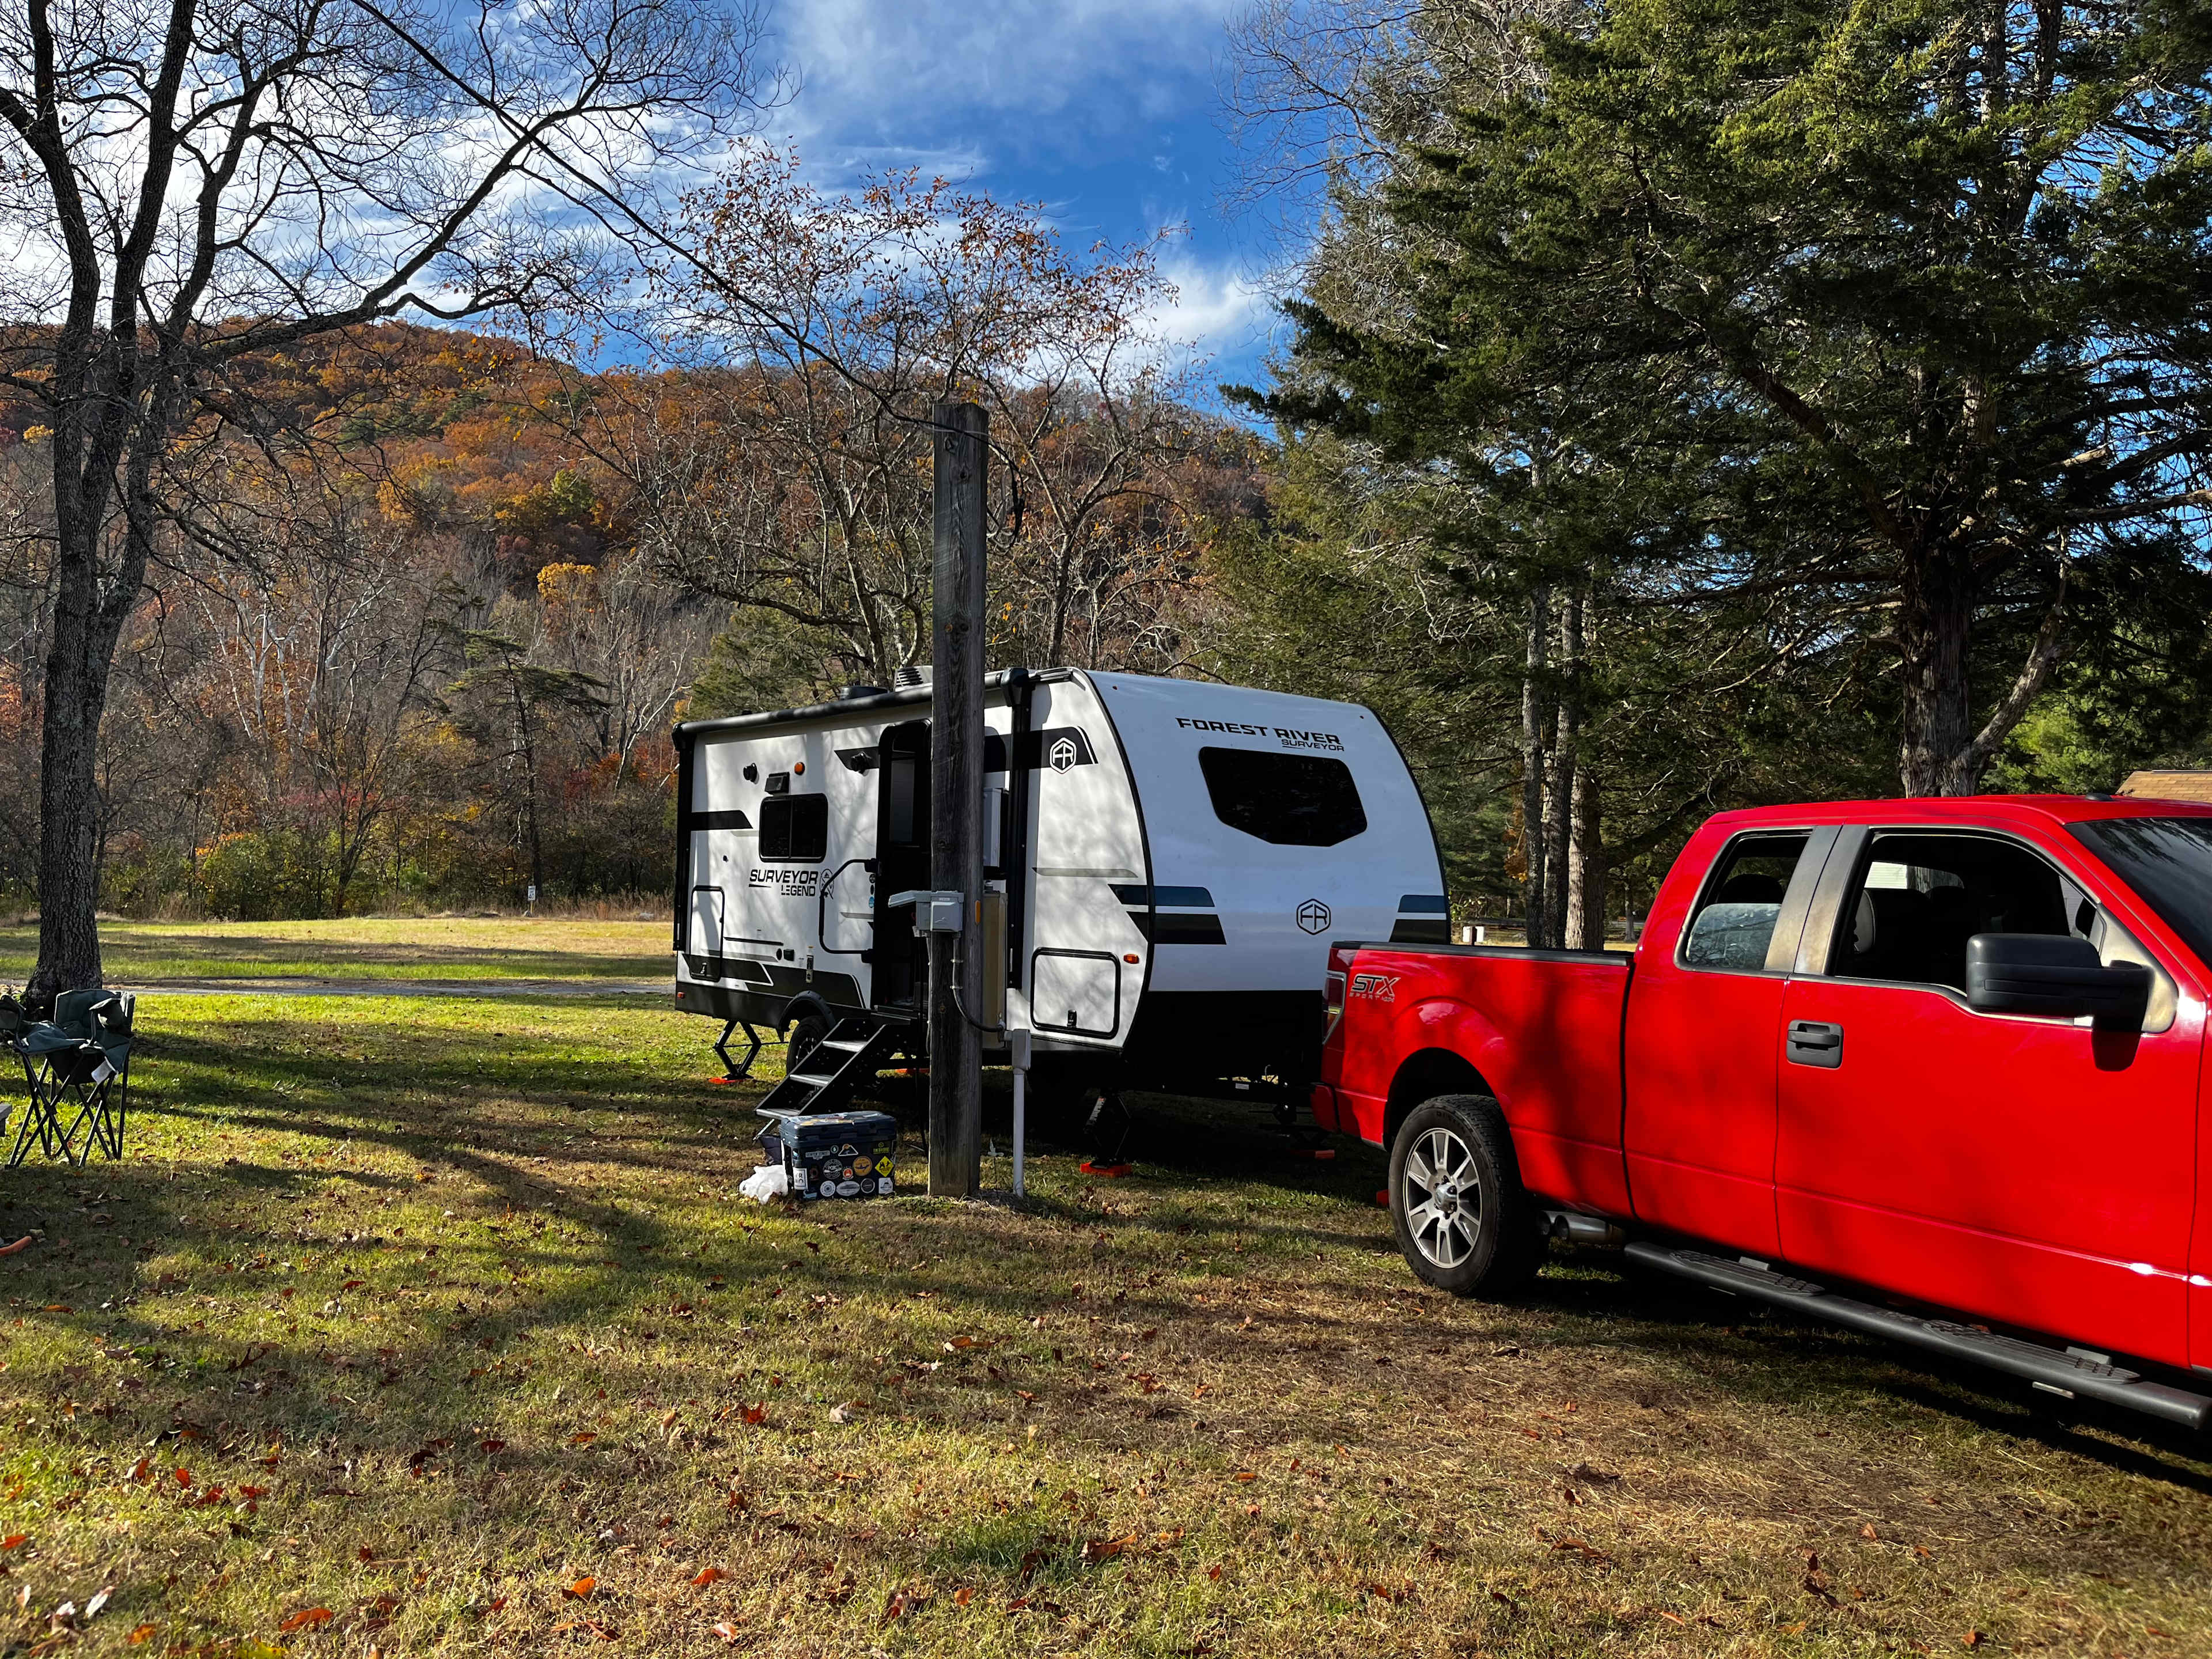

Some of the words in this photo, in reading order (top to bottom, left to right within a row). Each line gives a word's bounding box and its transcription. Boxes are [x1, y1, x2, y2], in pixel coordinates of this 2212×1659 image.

[1175, 717, 1268, 737] FOREST
[1272, 728, 1342, 745] RIVER
[1281, 739, 1345, 752] SURVEYOR
[749, 869, 819, 884] SURVEYOR
[781, 884, 816, 897] LEGEND
[1351, 974, 1400, 997] STX
